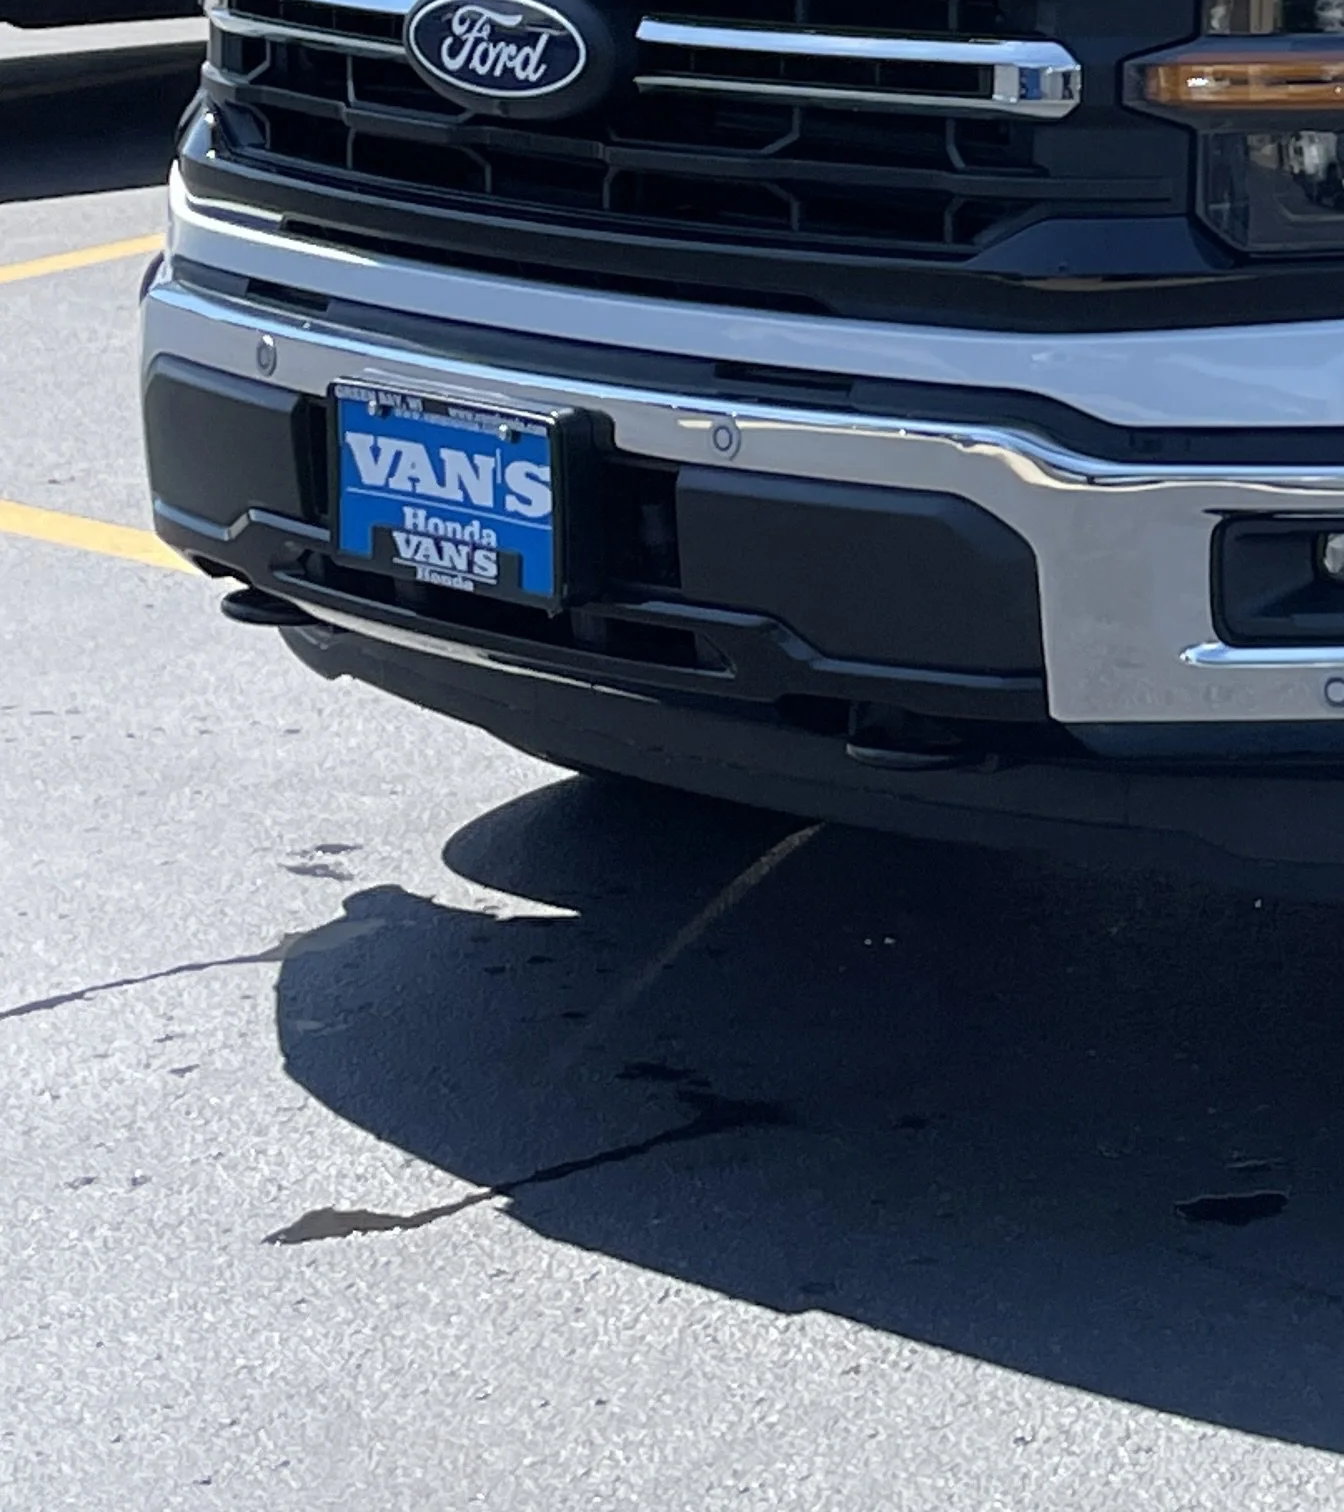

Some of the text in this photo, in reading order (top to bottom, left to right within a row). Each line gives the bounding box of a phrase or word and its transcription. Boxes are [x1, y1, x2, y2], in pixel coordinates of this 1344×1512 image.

[440, 4, 550, 82] Ford
[345, 431, 552, 517] VAN'S
[402, 506, 497, 548] Honda
[416, 567, 474, 592] Honda
